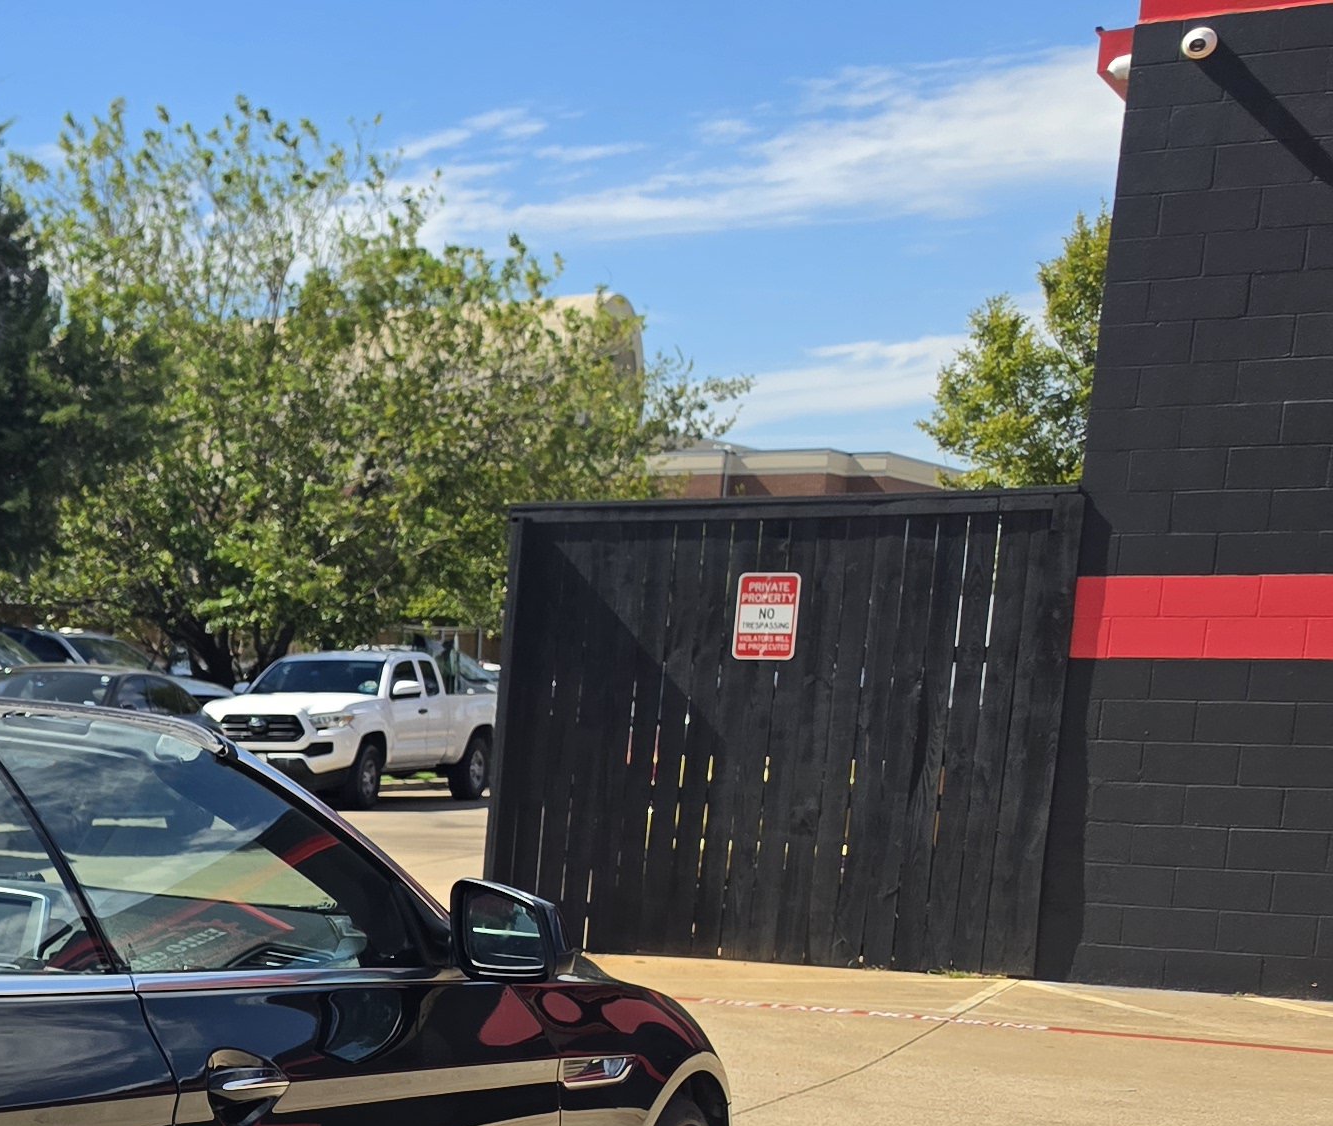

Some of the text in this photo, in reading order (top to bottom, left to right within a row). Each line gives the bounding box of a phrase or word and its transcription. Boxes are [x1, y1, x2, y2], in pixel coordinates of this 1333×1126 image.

[748, 582, 791, 593] PRIVATE
[741, 593, 795, 603] PROPERTY
[758, 608, 775, 620] NO
[742, 621, 790, 630] TRESPASSING
